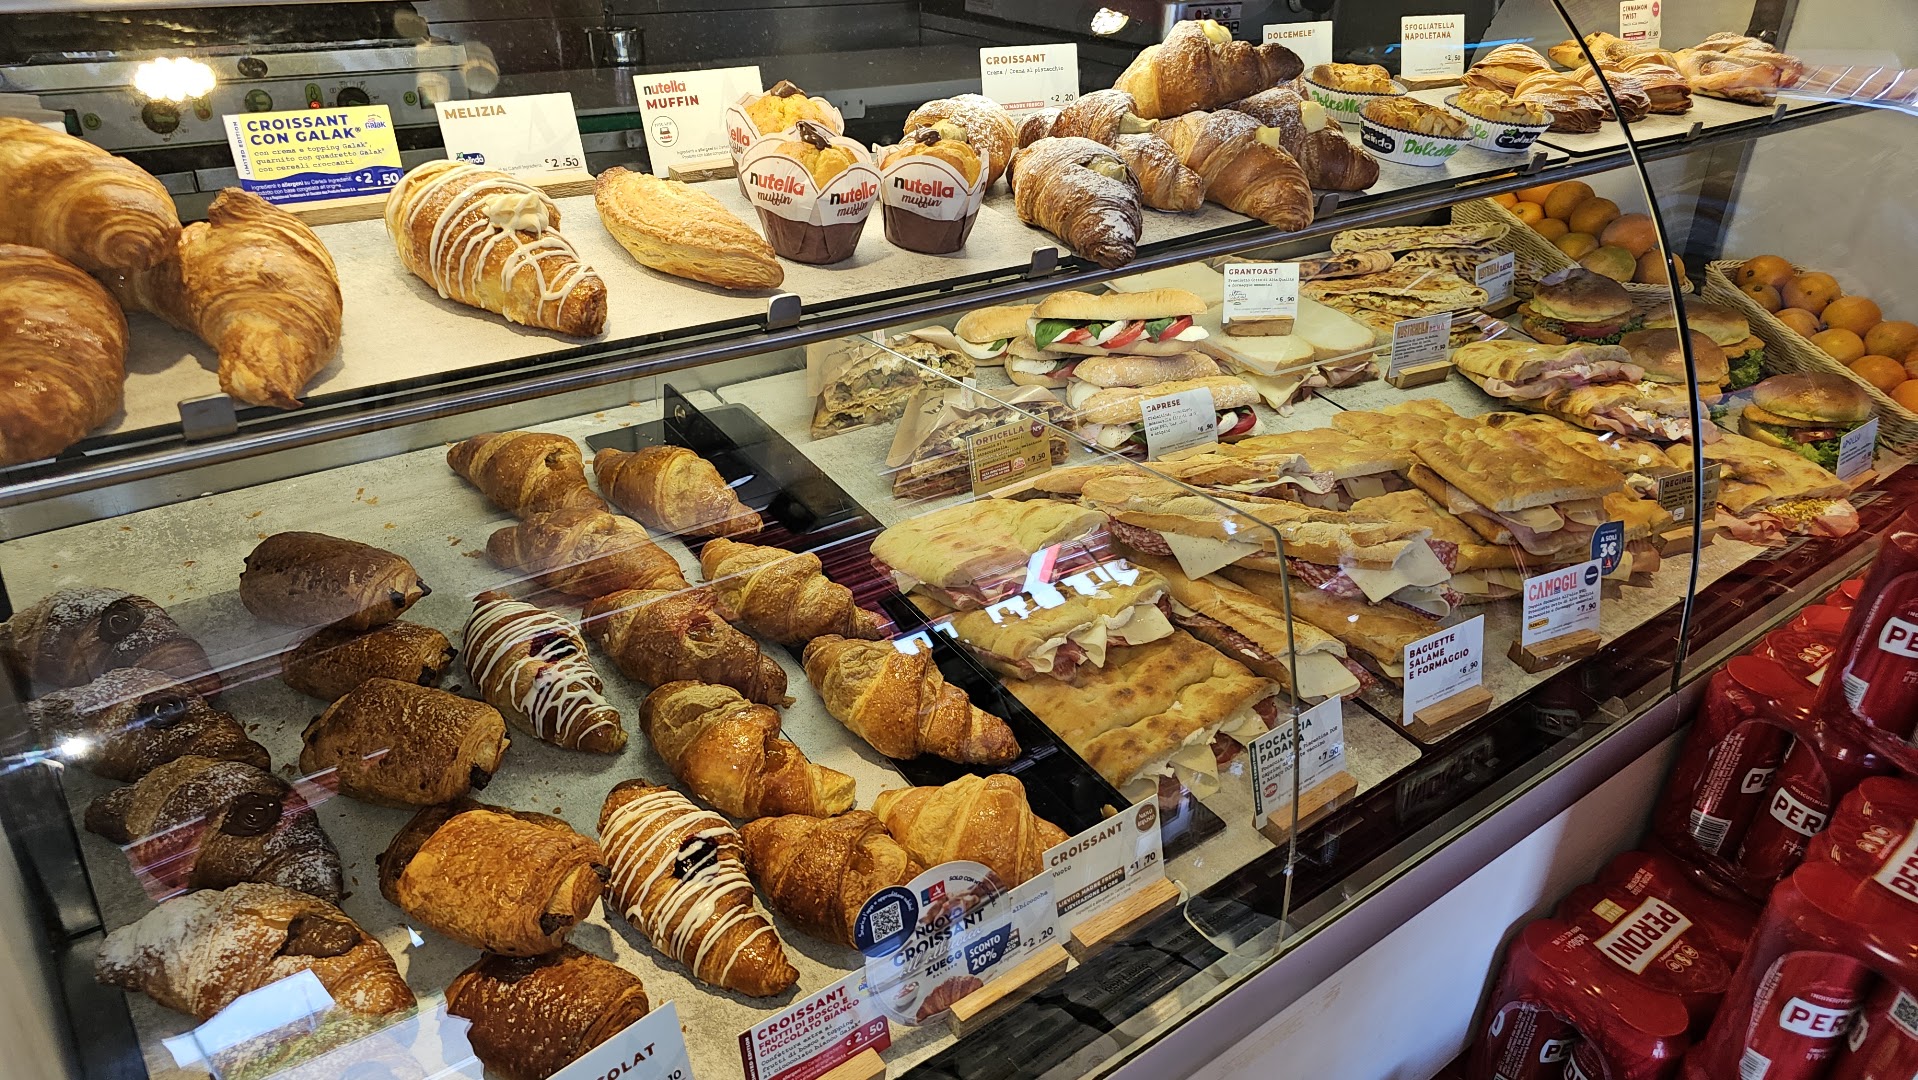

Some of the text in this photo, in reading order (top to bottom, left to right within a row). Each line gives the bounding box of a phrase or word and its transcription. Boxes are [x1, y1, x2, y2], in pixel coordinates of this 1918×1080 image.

[1404, 22, 1455, 31] SFOGLIATELLA
[1404, 31, 1451, 40] NAPOLETANA
[985, 53, 1046, 65] CROISSANT
[643, 80, 687, 95] nutella
[444, 104, 507, 120] MELIZIA
[646, 95, 700, 110] MUFFIN
[247, 114, 349, 132] CROISSANT
[232, 121, 251, 176] LIMITED EDITION
[250, 132, 290, 146] CON
[307, 144, 340, 154] topping
[749, 172, 805, 196] nutella
[829, 181, 878, 206] nutella
[893, 176, 955, 199] nutella
[757, 191, 793, 207] muffin
[901, 194, 943, 207] muffin
[1146, 399, 1181, 413] CAPRESE
[976, 425, 1024, 446] ORTICELLA
[1600, 542, 1617, 558] 3€
[1528, 572, 1578, 601] CAMOGLI
[1409, 633, 1455, 659] BAGUETTE
[1409, 648, 1445, 670] SALAME
[1409, 648, 1469, 680] E FORMAGGIO
[1050, 822, 1123, 867] CROISSANT
[1052, 866, 1072, 878] Vuoto
[1058, 892, 1080, 908] LIEVITO
[1081, 881, 1101, 896] MADRE
[1101, 869, 1123, 884] FRESCO
[915, 906, 963, 940] NUOVO
[893, 908, 985, 967] CROISSANT
[1605, 903, 1681, 966] PERONI
[969, 935, 1001, 957] SCONTO
[925, 950, 963, 977] ZUEGG
[971, 950, 998, 971] 20%
[757, 985, 846, 1041] CROISSANT
[758, 996, 849, 1051] FRUTTI DI BOSCO E
[759, 999, 860, 1058] CIOCCOLATO BIANCO
[827, 1019, 855, 1039] topping
[744, 1036, 753, 1061] EDITION
[761, 1041, 802, 1067] Confettura
